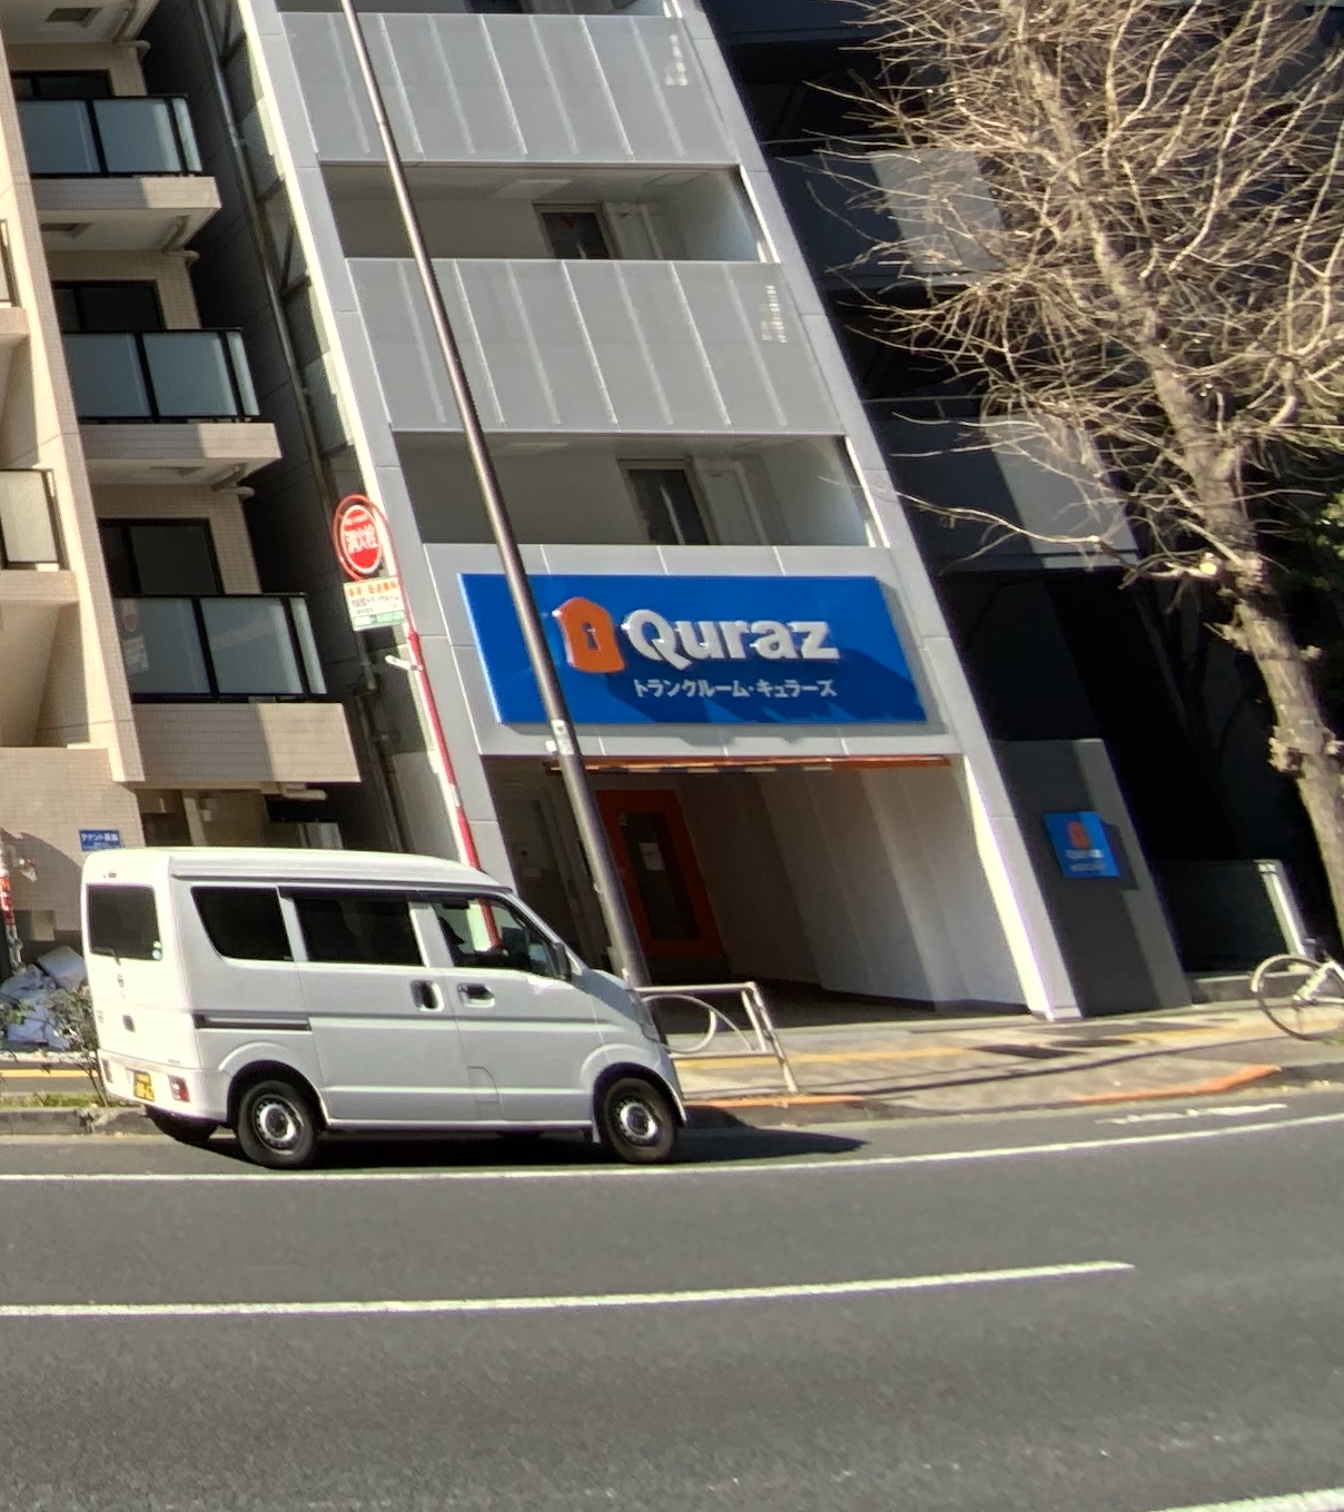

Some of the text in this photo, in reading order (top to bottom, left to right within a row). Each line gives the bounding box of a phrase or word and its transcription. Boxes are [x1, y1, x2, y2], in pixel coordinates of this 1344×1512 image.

[621, 608, 840, 671] Quraz
[632, 678, 839, 698] トランクルーム・キュラーズ
